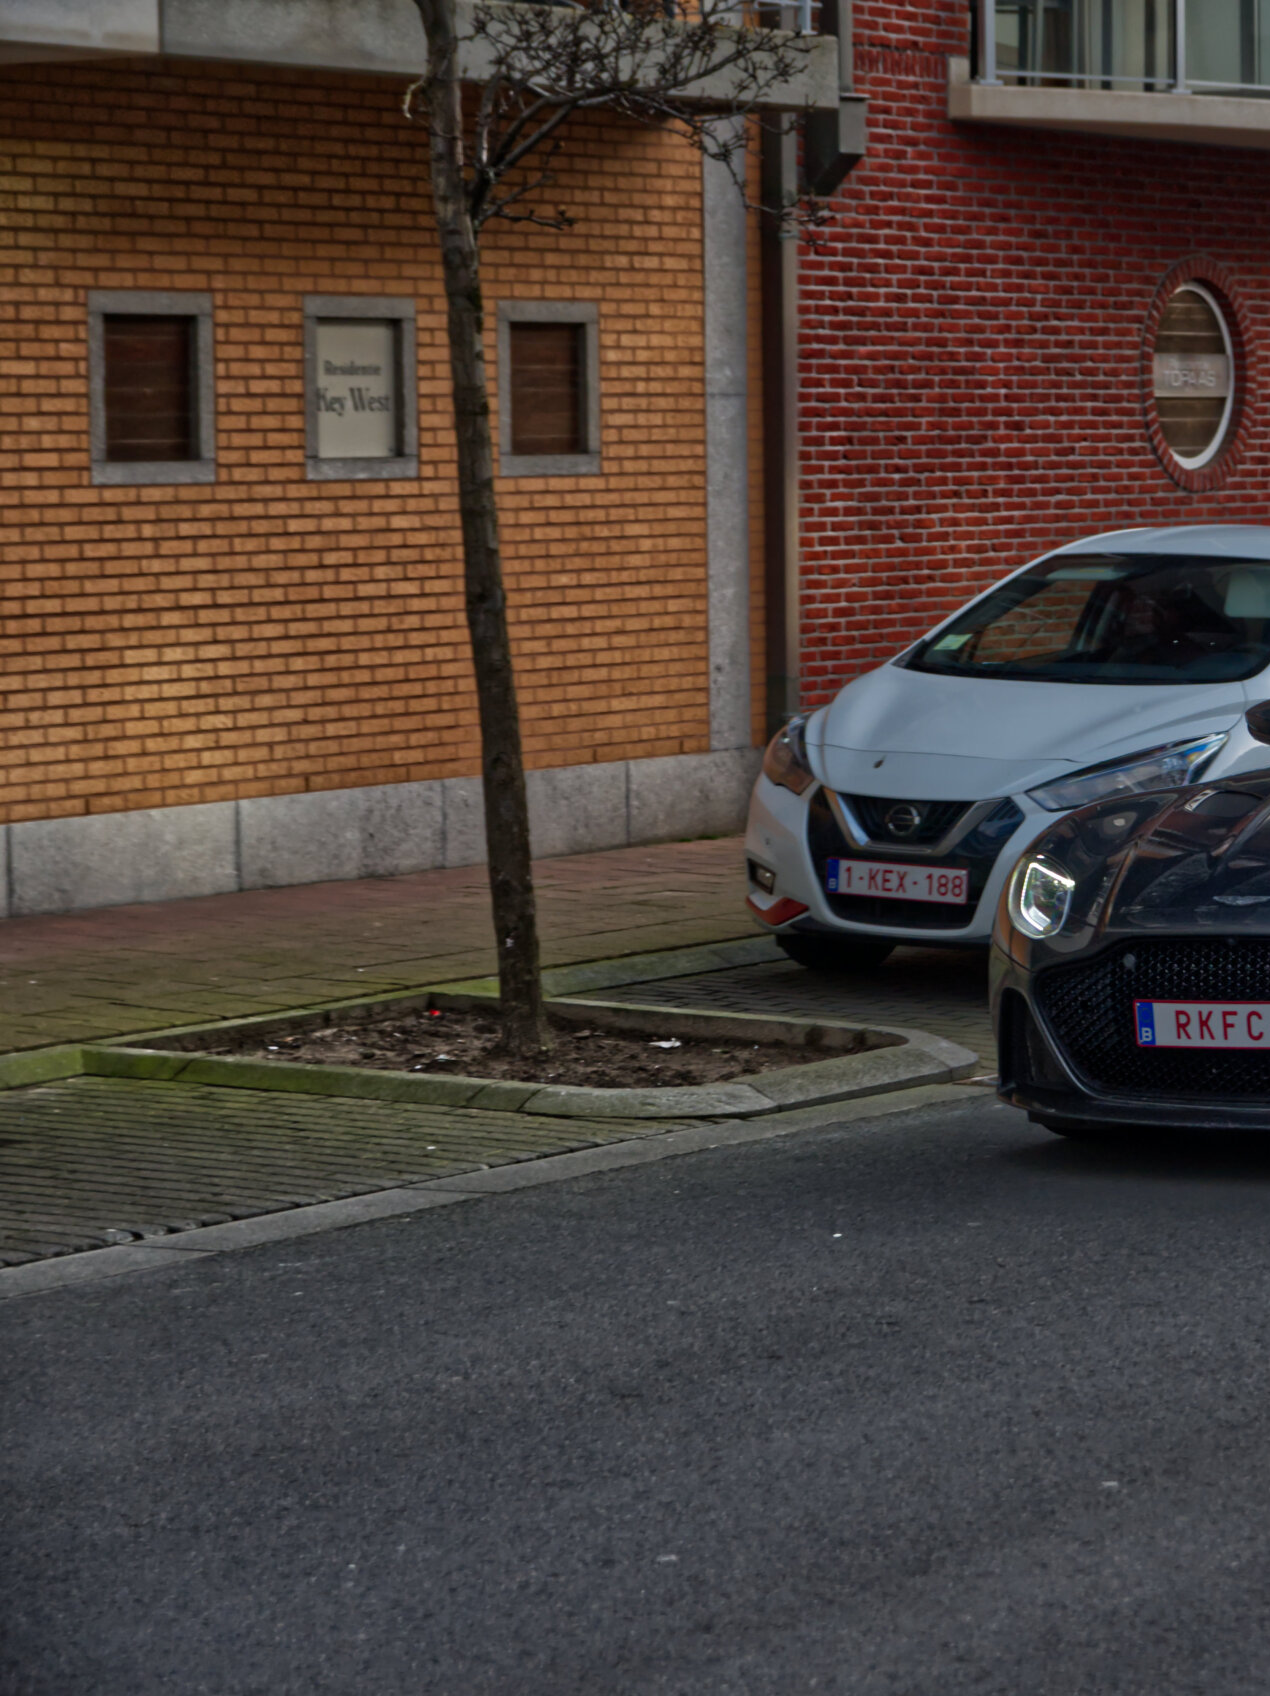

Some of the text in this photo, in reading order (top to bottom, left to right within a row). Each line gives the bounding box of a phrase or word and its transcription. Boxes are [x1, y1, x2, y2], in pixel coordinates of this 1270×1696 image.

[316, 387, 391, 417] Key West
[844, 865, 964, 897] 1-KEX-188
[1141, 1027, 1153, 1042] B
